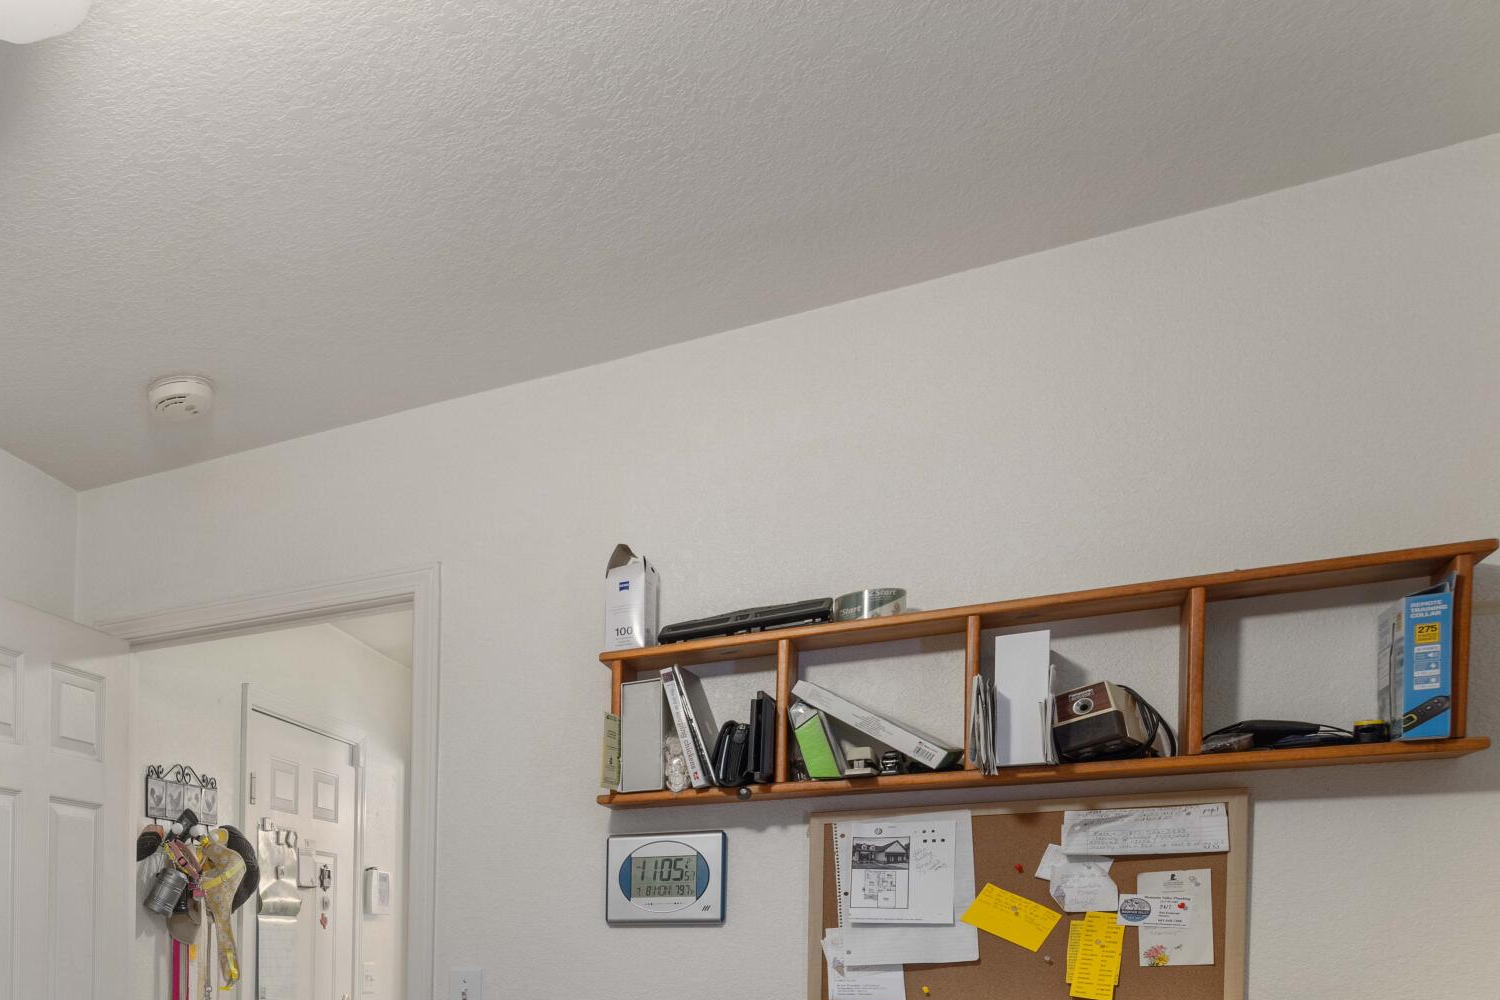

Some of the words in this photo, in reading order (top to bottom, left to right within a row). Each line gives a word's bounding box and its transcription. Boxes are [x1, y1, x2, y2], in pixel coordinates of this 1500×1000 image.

[1410, 610, 1441, 619] COLLAR
[615, 626, 633, 636] 100
[1417, 624, 1438, 634] 275
[684, 739, 696, 770] chickens
